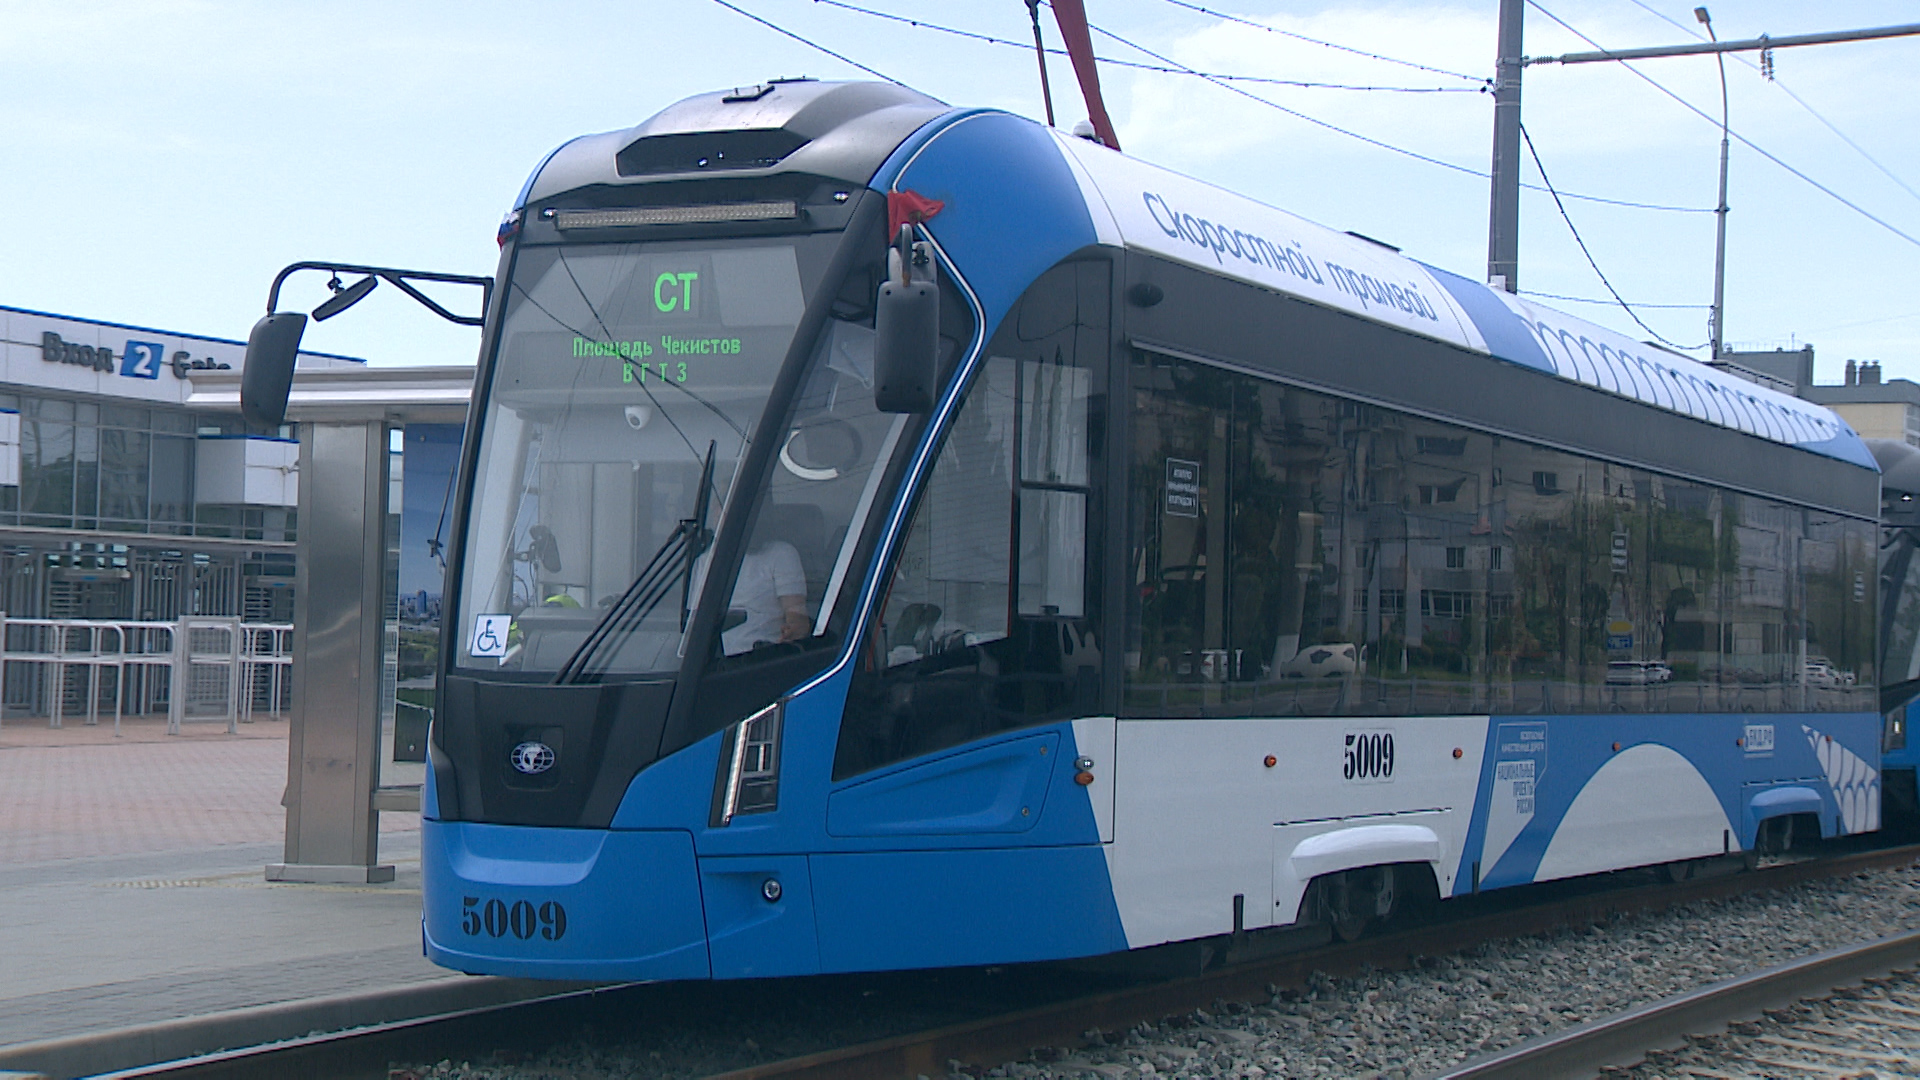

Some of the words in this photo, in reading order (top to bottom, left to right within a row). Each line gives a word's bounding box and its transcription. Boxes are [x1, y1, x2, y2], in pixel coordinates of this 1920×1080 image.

[1142, 191, 1324, 286] Скоростной
[1324, 259, 1439, 322] трамвай
[654, 272, 698, 312] СТ
[42, 331, 114, 374] Вход
[133, 345, 152, 376] 2
[573, 337, 652, 358] Площадь
[661, 335, 741, 355] Чекистов
[1344, 733, 1394, 780] 5009
[462, 896, 567, 941] 5009
